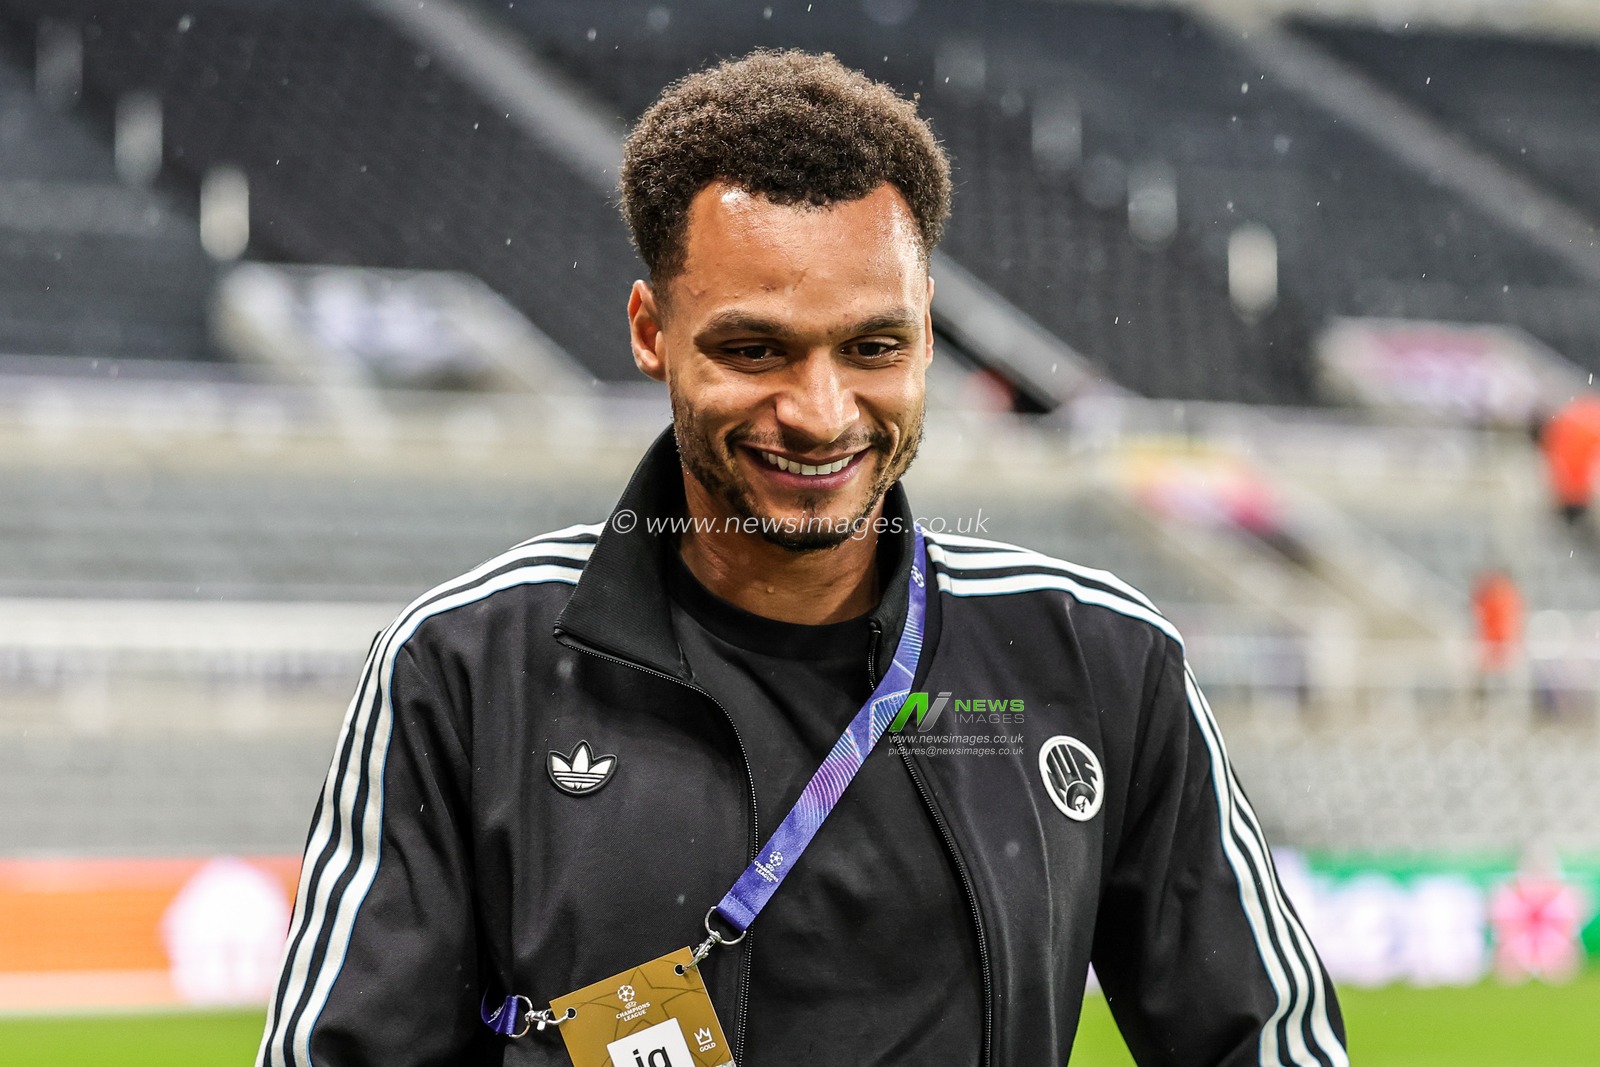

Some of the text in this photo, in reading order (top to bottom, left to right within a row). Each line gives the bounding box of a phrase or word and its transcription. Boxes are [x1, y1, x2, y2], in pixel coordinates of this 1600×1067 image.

[615, 1001, 651, 1019] CHAMPIONS
[623, 1009, 647, 1022] LEAGUE
[699, 1042, 717, 1053] GOLD
